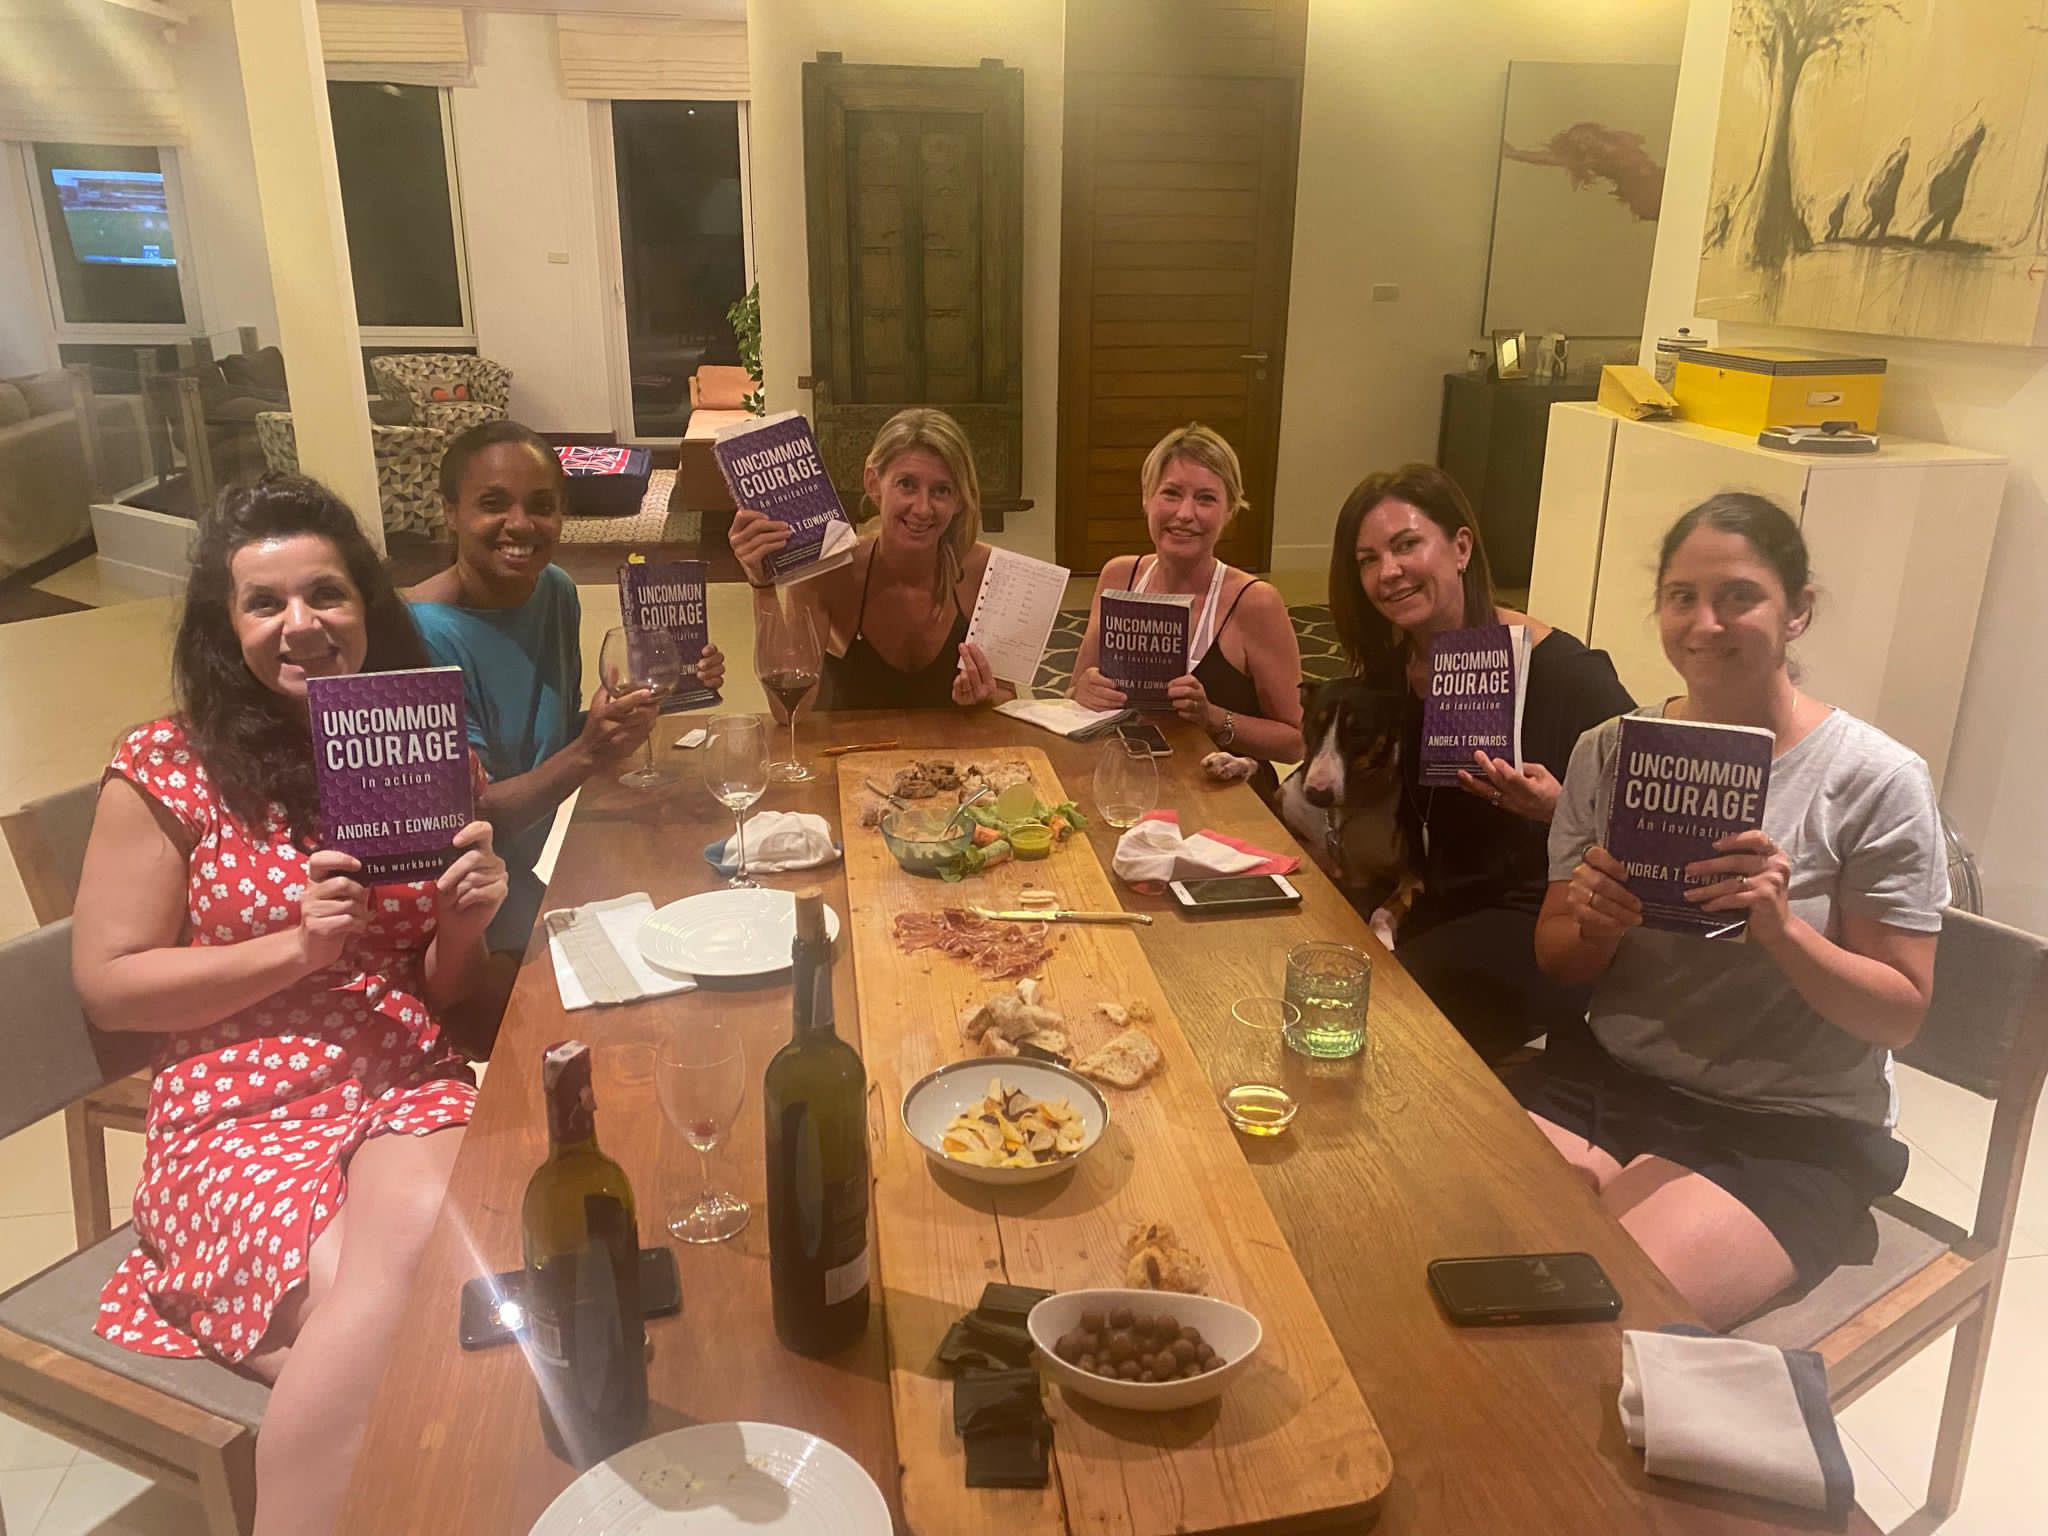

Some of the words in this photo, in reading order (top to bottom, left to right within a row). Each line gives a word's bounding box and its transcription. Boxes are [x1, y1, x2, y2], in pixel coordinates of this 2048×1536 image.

[732, 437, 813, 478] UNCOMMON
[740, 455, 822, 499] COURAGE
[760, 500, 771, 509] An
[773, 484, 819, 504] Invitation
[795, 521, 802, 531] T
[802, 508, 840, 529] EDWARDS
[638, 584, 702, 604] UNCOMMON
[640, 603, 704, 630] COURAGE
[1105, 615, 1182, 635] UNCOMMON
[1105, 631, 1182, 653] COURAGE
[1434, 649, 1509, 673] UNCOMMON
[1432, 670, 1510, 697] COURAGE
[1440, 702, 1450, 710] An
[1454, 701, 1501, 711] Invitation
[323, 703, 457, 737] UNCOMMON
[326, 730, 460, 770] COURAGE
[1428, 735, 1459, 747] ANDREA
[1462, 735, 1467, 747] T
[1468, 735, 1508, 747] EDWARDS
[362, 776, 376, 789] In
[384, 772, 432, 788] action
[1629, 751, 1763, 791] UNCOMMON
[1625, 779, 1760, 823] COURAGE
[337, 822, 390, 841] ANDREA
[393, 820, 400, 835] T
[405, 813, 465, 834] EDWARDS
[1637, 818, 1654, 831] An
[367, 864, 386, 874] The
[392, 857, 444, 873] workbook
[1622, 861, 1668, 881] NDREA
[1673, 867, 1680, 881] T
